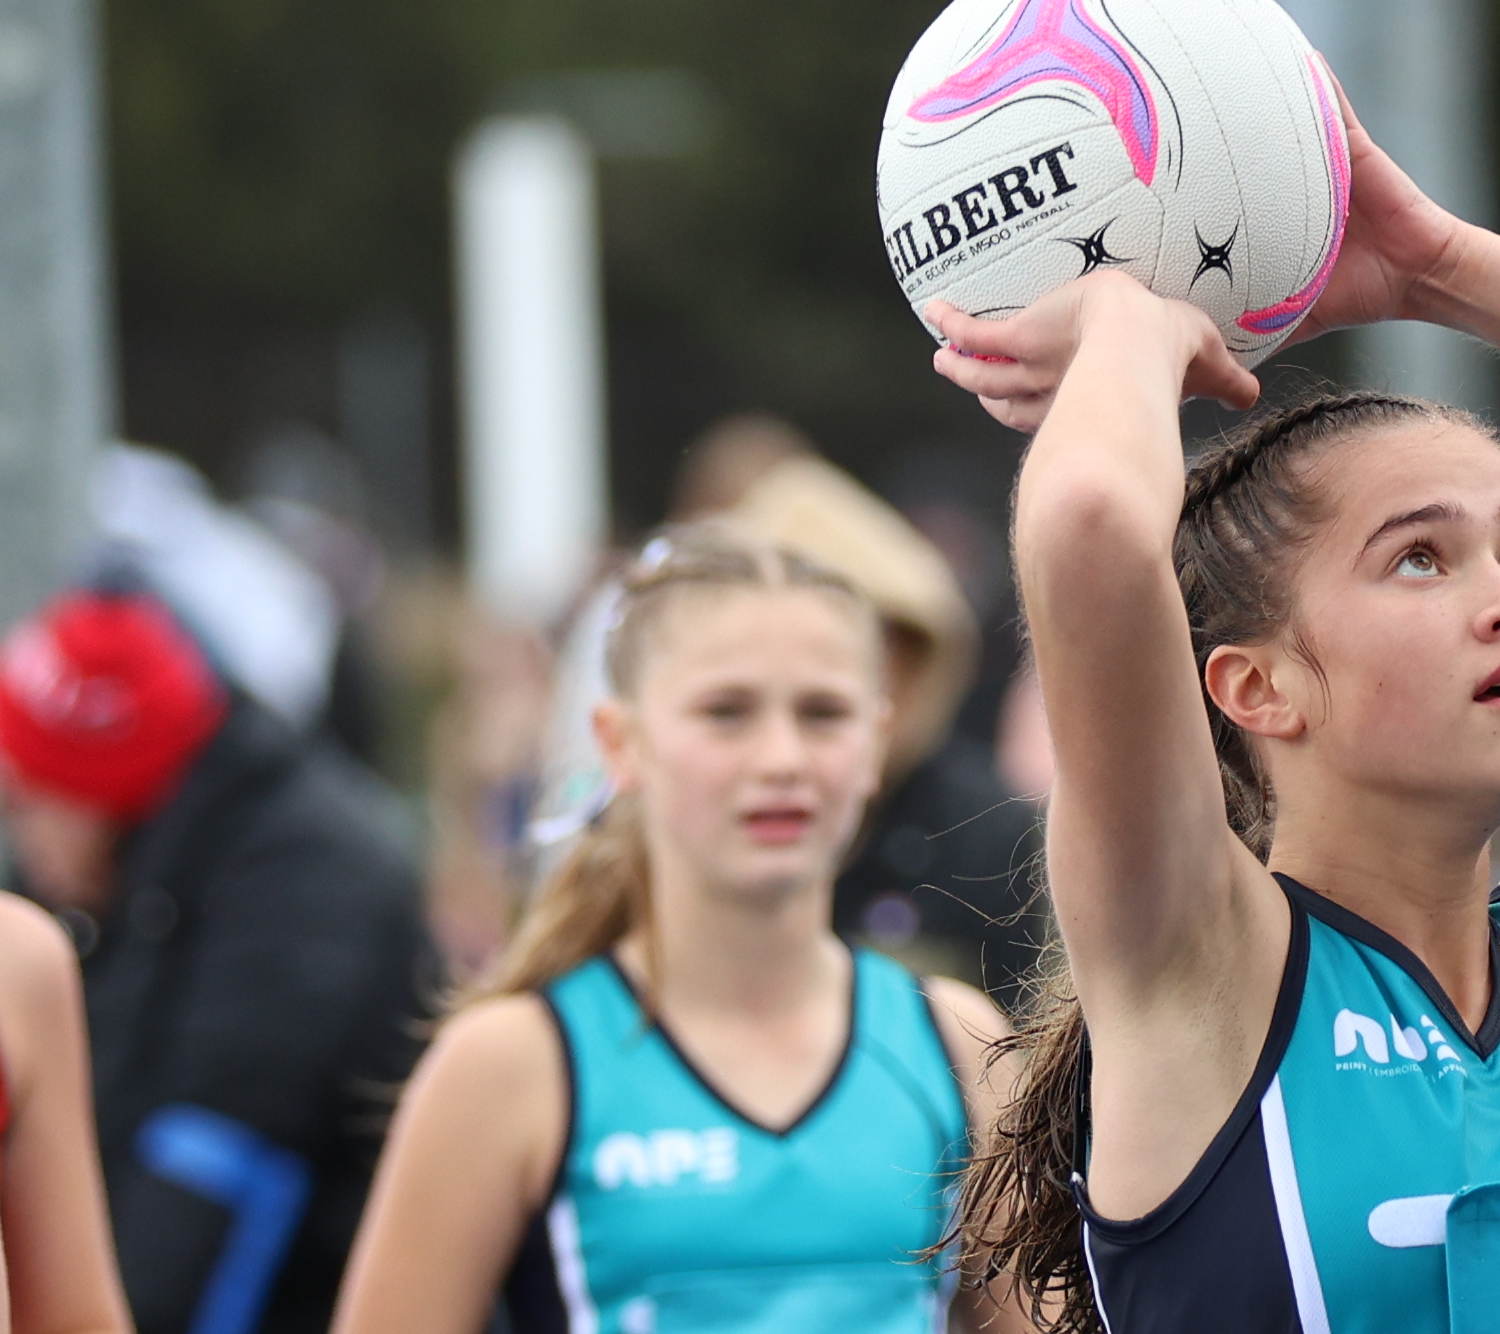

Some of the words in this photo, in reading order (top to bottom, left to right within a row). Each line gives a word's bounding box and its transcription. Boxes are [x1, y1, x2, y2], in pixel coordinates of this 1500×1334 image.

[969, 228, 1012, 257] M500
[1015, 201, 1074, 232] NETBALL
[1335, 1061, 1367, 1072] PRINT
